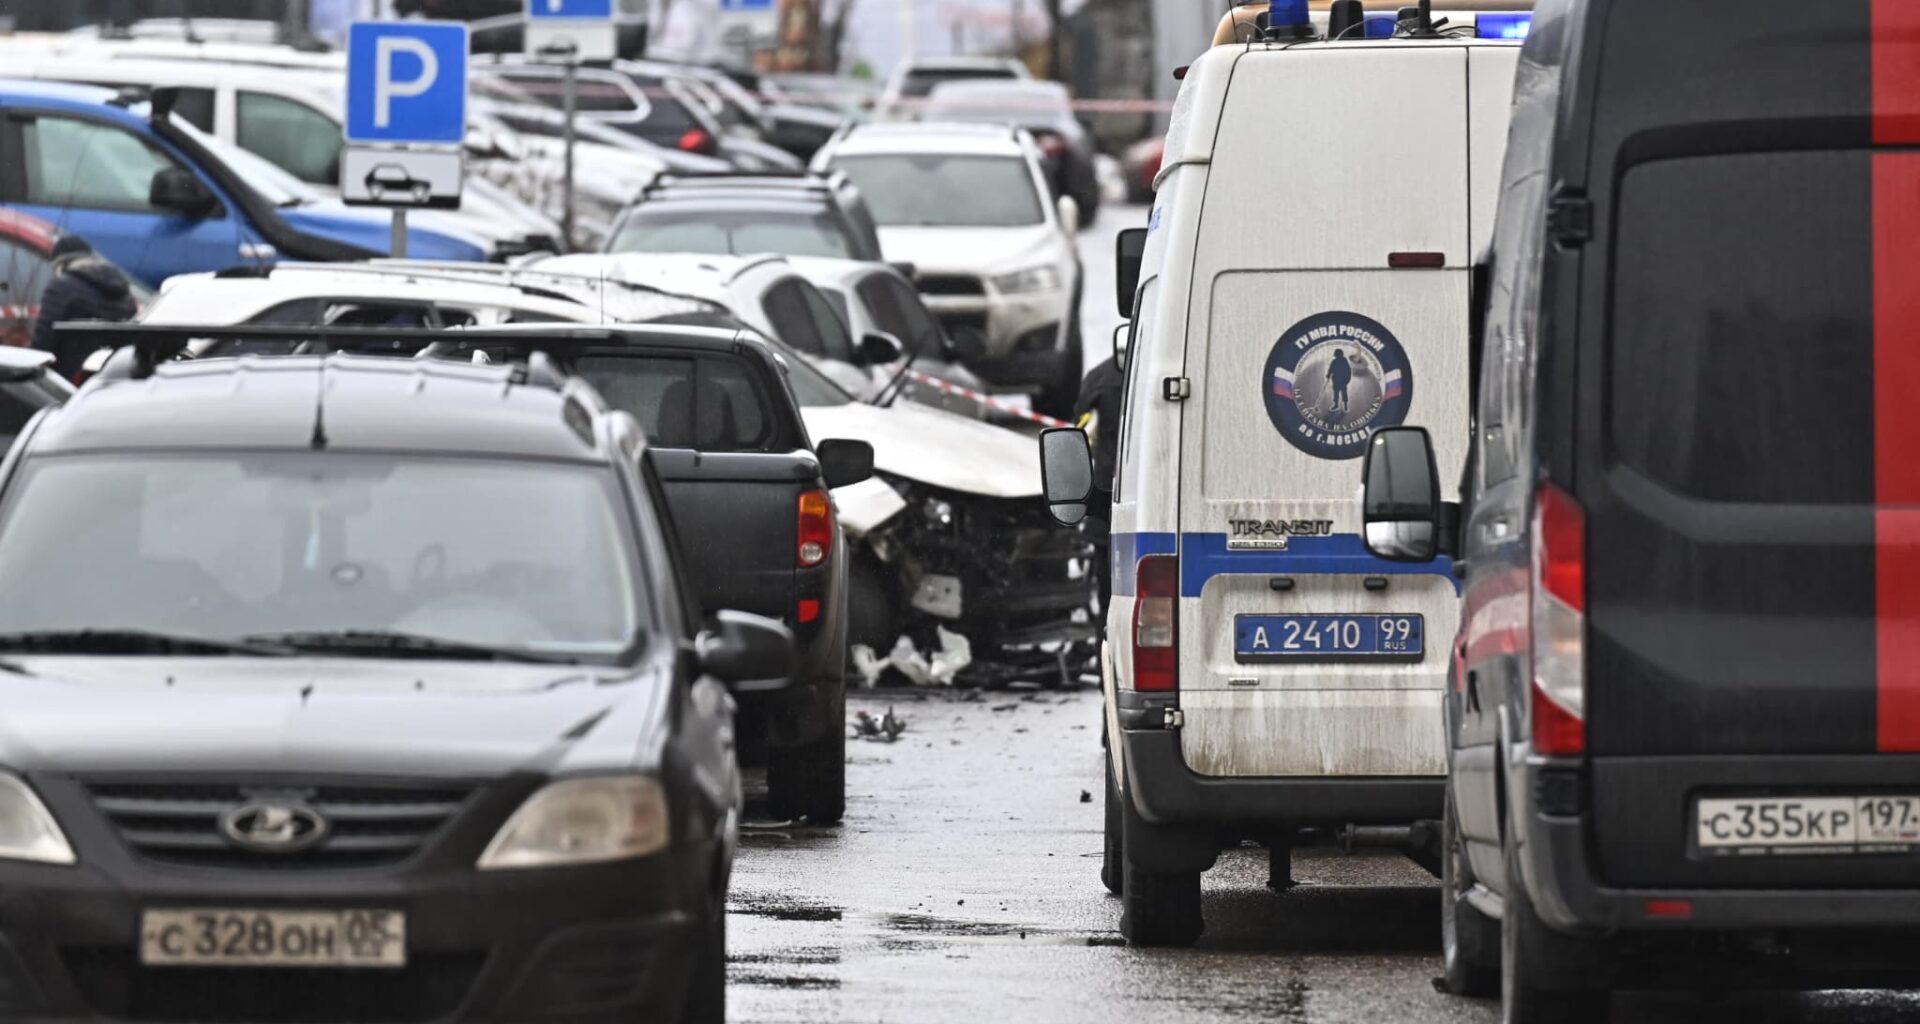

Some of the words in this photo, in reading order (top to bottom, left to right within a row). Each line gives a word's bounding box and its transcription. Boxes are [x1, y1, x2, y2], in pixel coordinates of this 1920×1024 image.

[374, 36, 439, 128] P
[1295, 334, 1310, 349] ГУ
[1308, 325, 1337, 340] МВД
[1340, 325, 1385, 351] РОССИИ
[1229, 519, 1333, 535] TRANSIT
[1253, 626, 1270, 648] А
[1283, 620, 1361, 649] 2410
[1380, 619, 1411, 641] 99
[1384, 641, 1407, 650] RUS
[1860, 800, 1911, 827] 197
